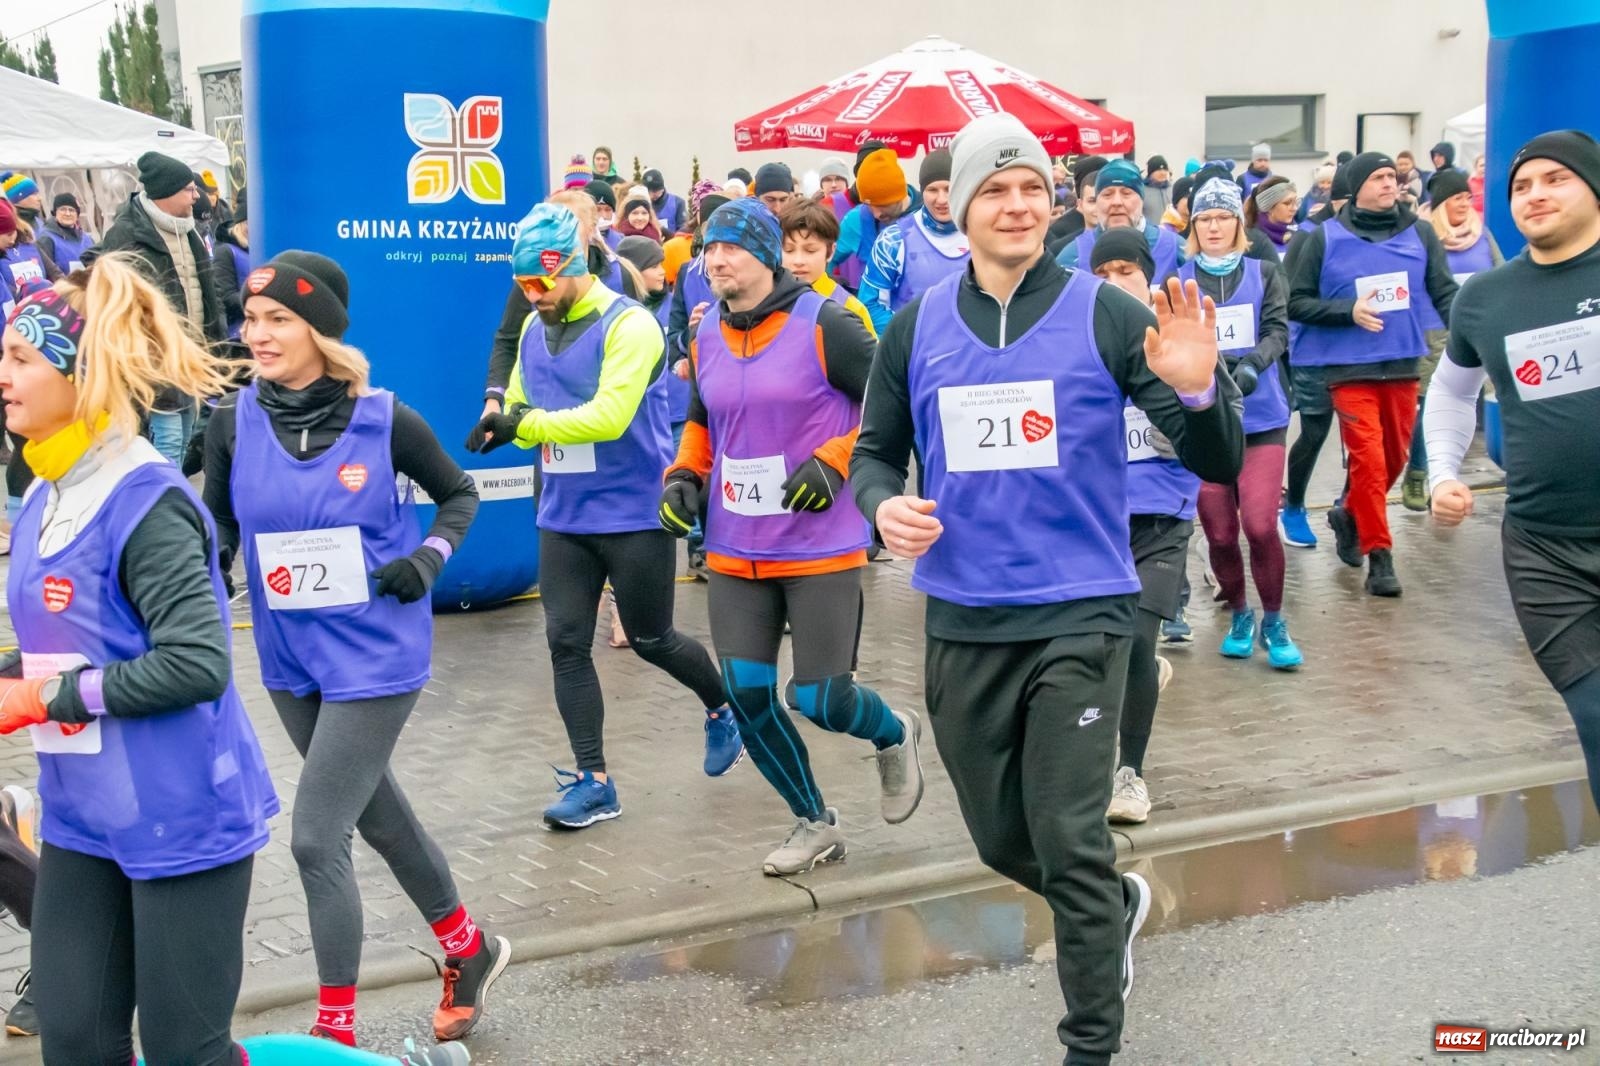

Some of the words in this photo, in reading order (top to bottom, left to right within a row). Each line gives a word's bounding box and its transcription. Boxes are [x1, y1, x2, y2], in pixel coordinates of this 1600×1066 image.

[851, 73, 905, 119] WARKA
[999, 148, 1019, 160] NIKE
[337, 219, 412, 239] GMINA
[386, 250, 423, 263] odkryj
[431, 251, 467, 264] poznaj
[1376, 287, 1395, 303] 65
[1543, 349, 1583, 381] 24
[977, 416, 1018, 449] 21
[734, 482, 763, 504] 74
[292, 563, 330, 593] 72
